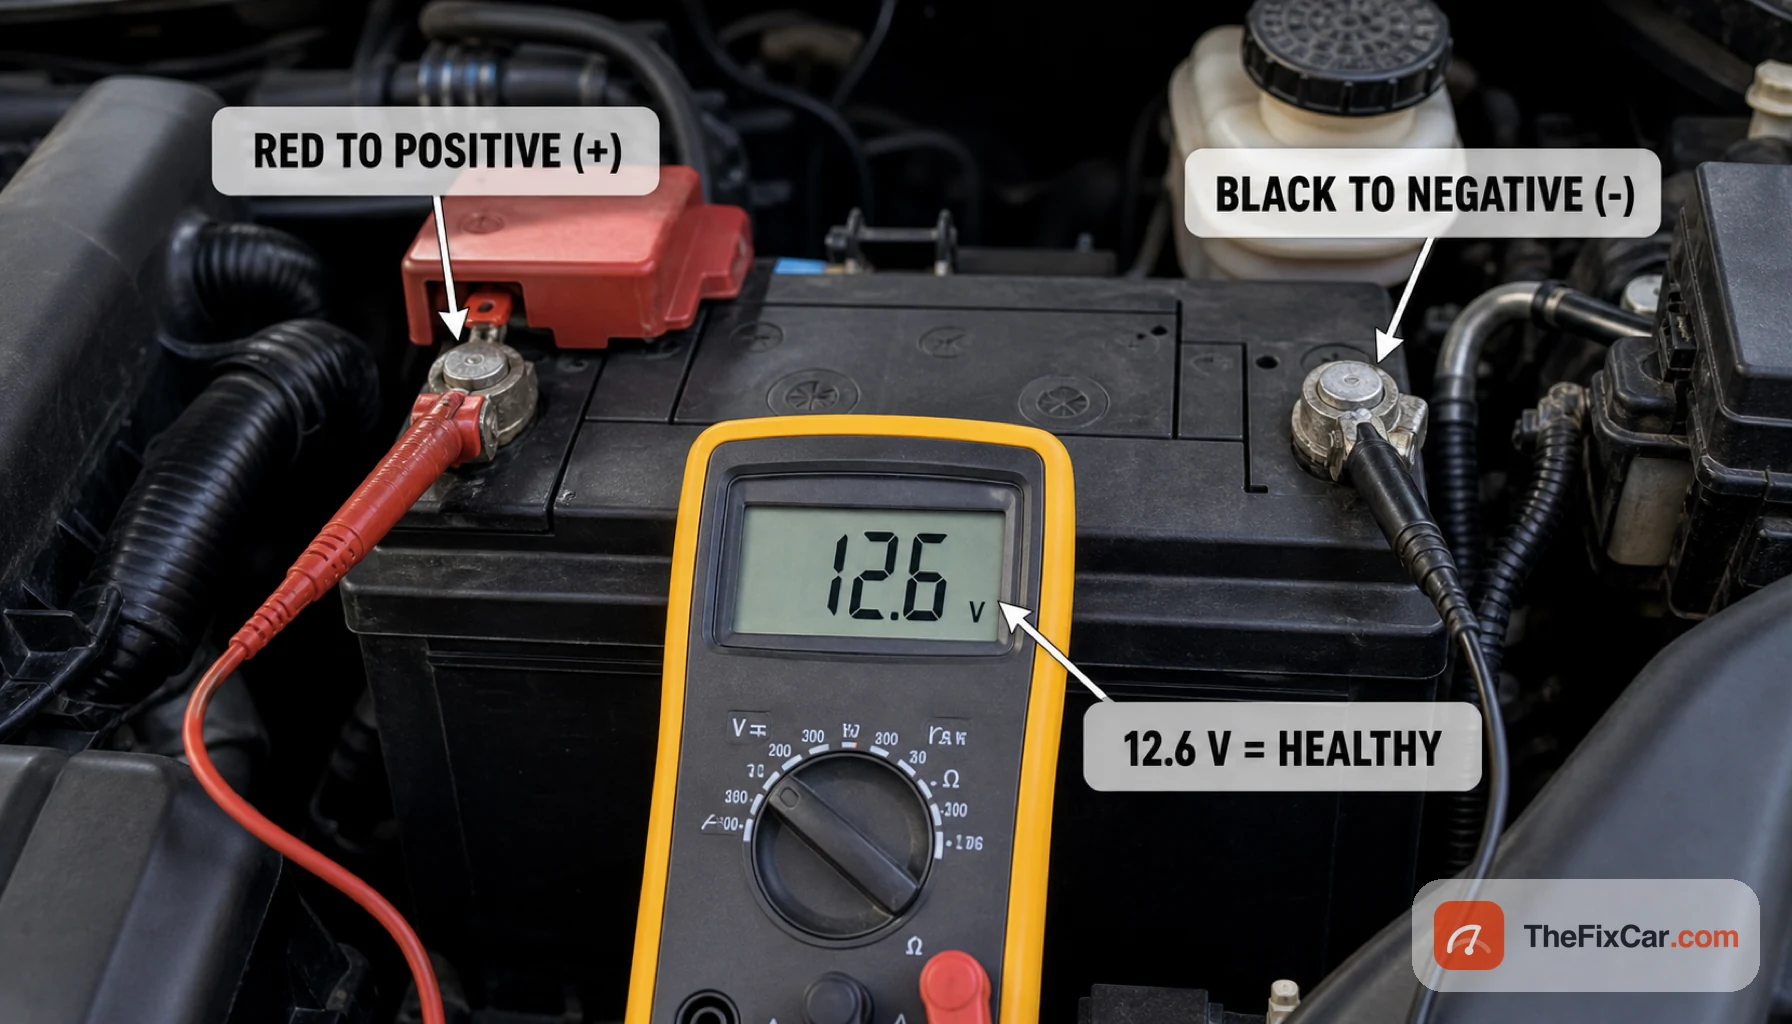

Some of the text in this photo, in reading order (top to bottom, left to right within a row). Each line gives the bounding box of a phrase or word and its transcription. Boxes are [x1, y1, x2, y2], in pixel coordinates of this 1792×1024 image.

[827, 531, 986, 623] 12.6 V
[768, 744, 792, 758] 200
